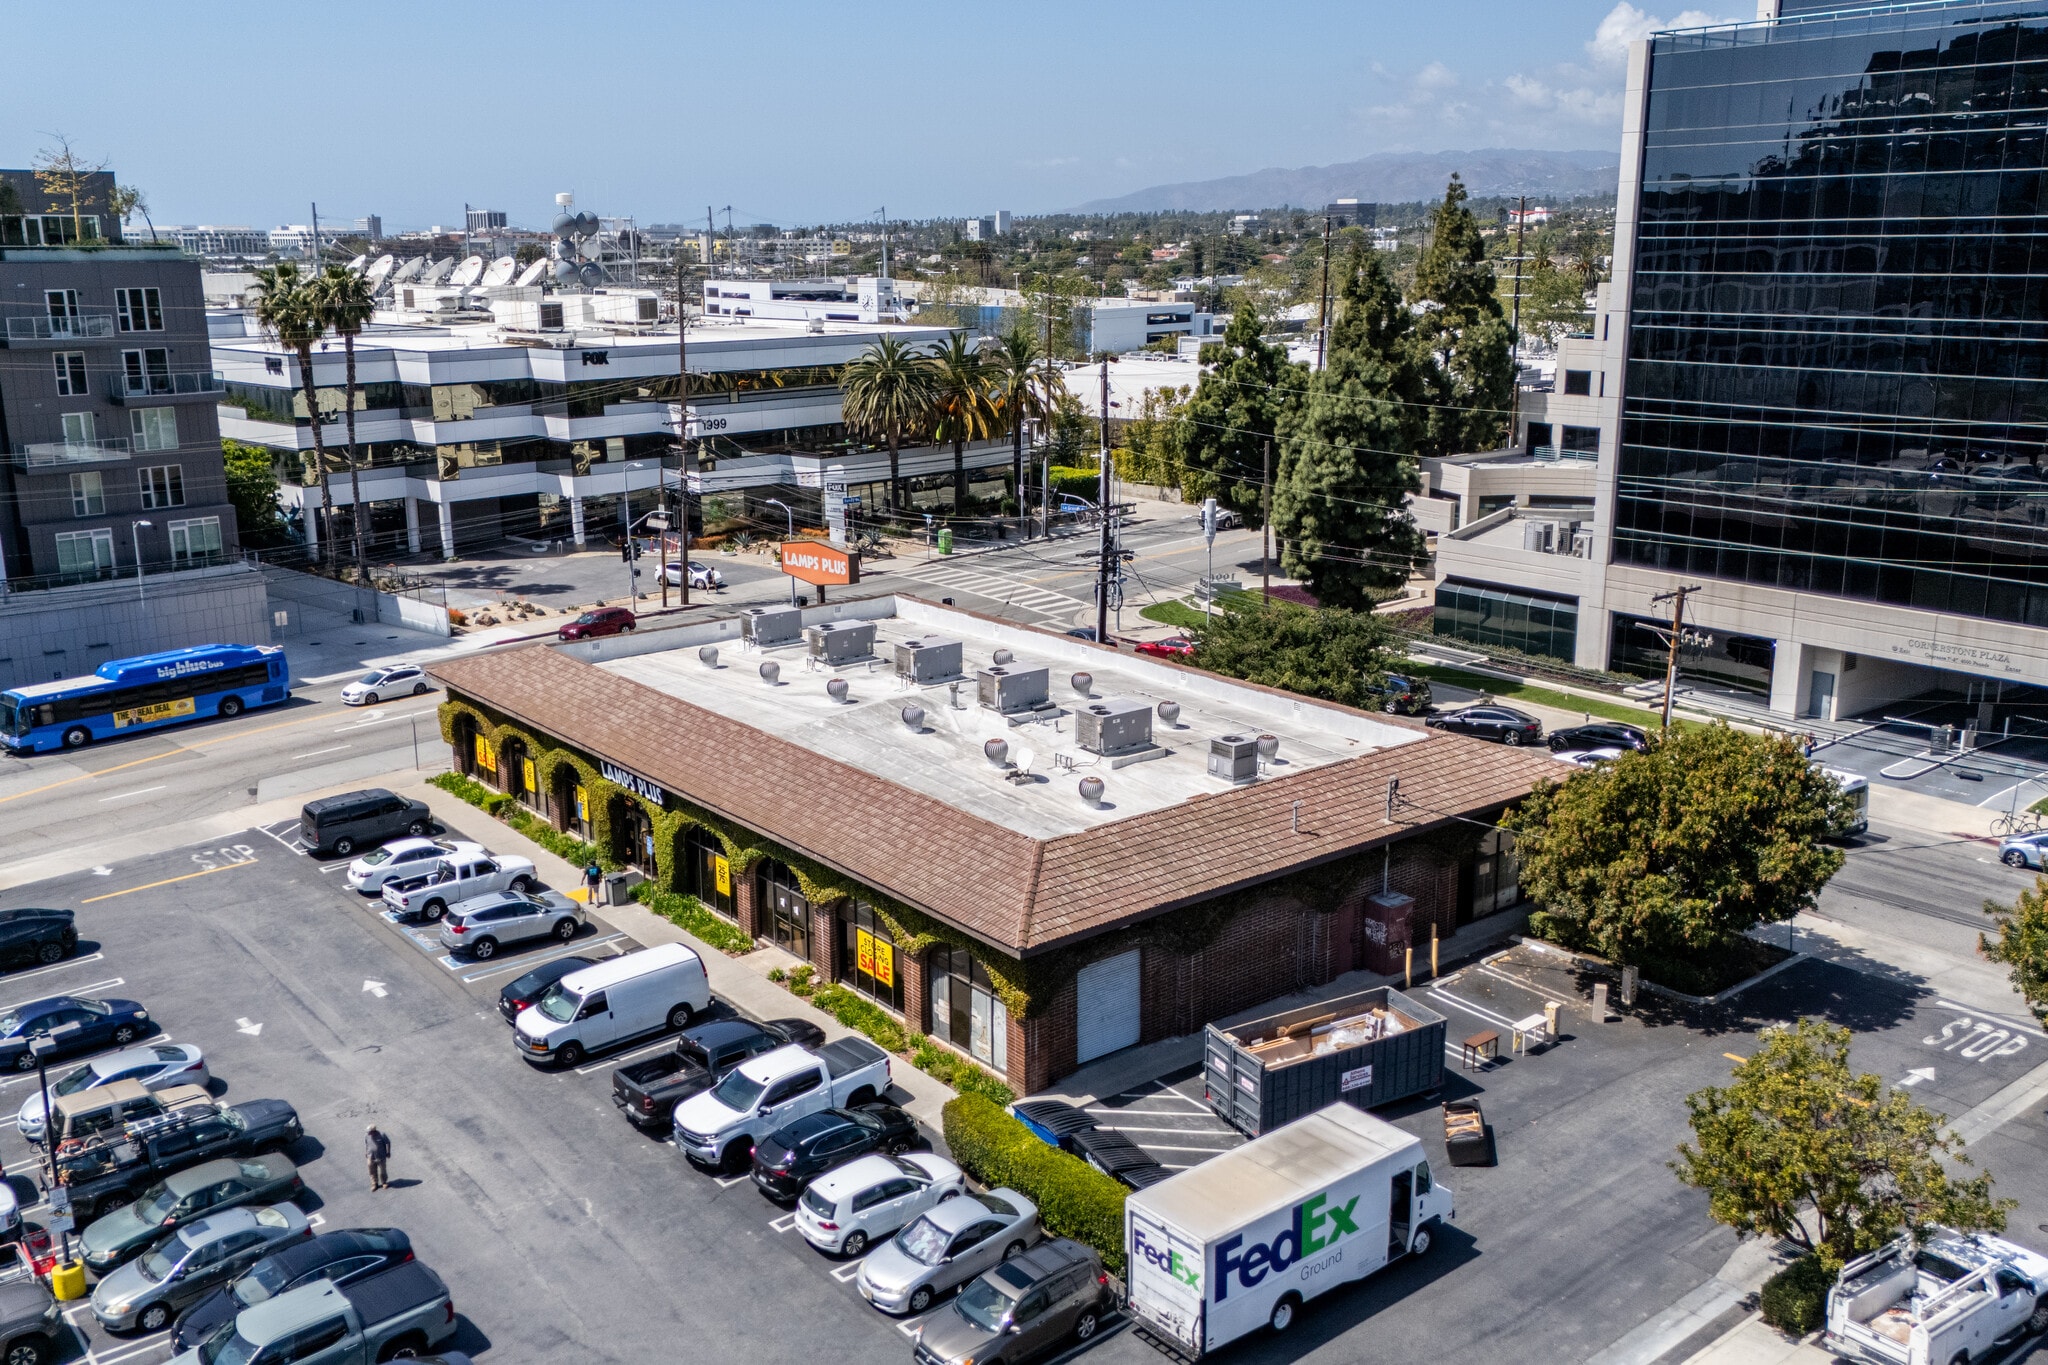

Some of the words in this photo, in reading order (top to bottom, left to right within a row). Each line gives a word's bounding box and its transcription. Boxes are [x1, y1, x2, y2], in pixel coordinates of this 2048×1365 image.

[582, 351, 609, 366] FOX
[702, 418, 727, 430] 1999
[828, 483, 843, 491] FOX
[784, 551, 819, 570] LAMPS
[821, 557, 847, 576] PLUS
[1908, 639, 1978, 658] CORNERSTONE
[1979, 651, 2011, 664] PLAZA
[116, 711, 129, 721] THE
[136, 707, 153, 717] REAL
[154, 703, 171, 713] DEAL
[600, 760, 635, 792] LAMPS
[637, 778, 664, 805] PLUS
[190, 844, 257, 870] STOP
[860, 944, 889, 966] CLOSING
[863, 937, 886, 956] STORE
[860, 952, 890, 982] SALE
[1922, 1017, 2028, 1063] STOP
[1134, 1228, 1200, 1292] FedEx
[1215, 1191, 1361, 1304] FedEx
[1300, 1248, 1343, 1281] Ground
